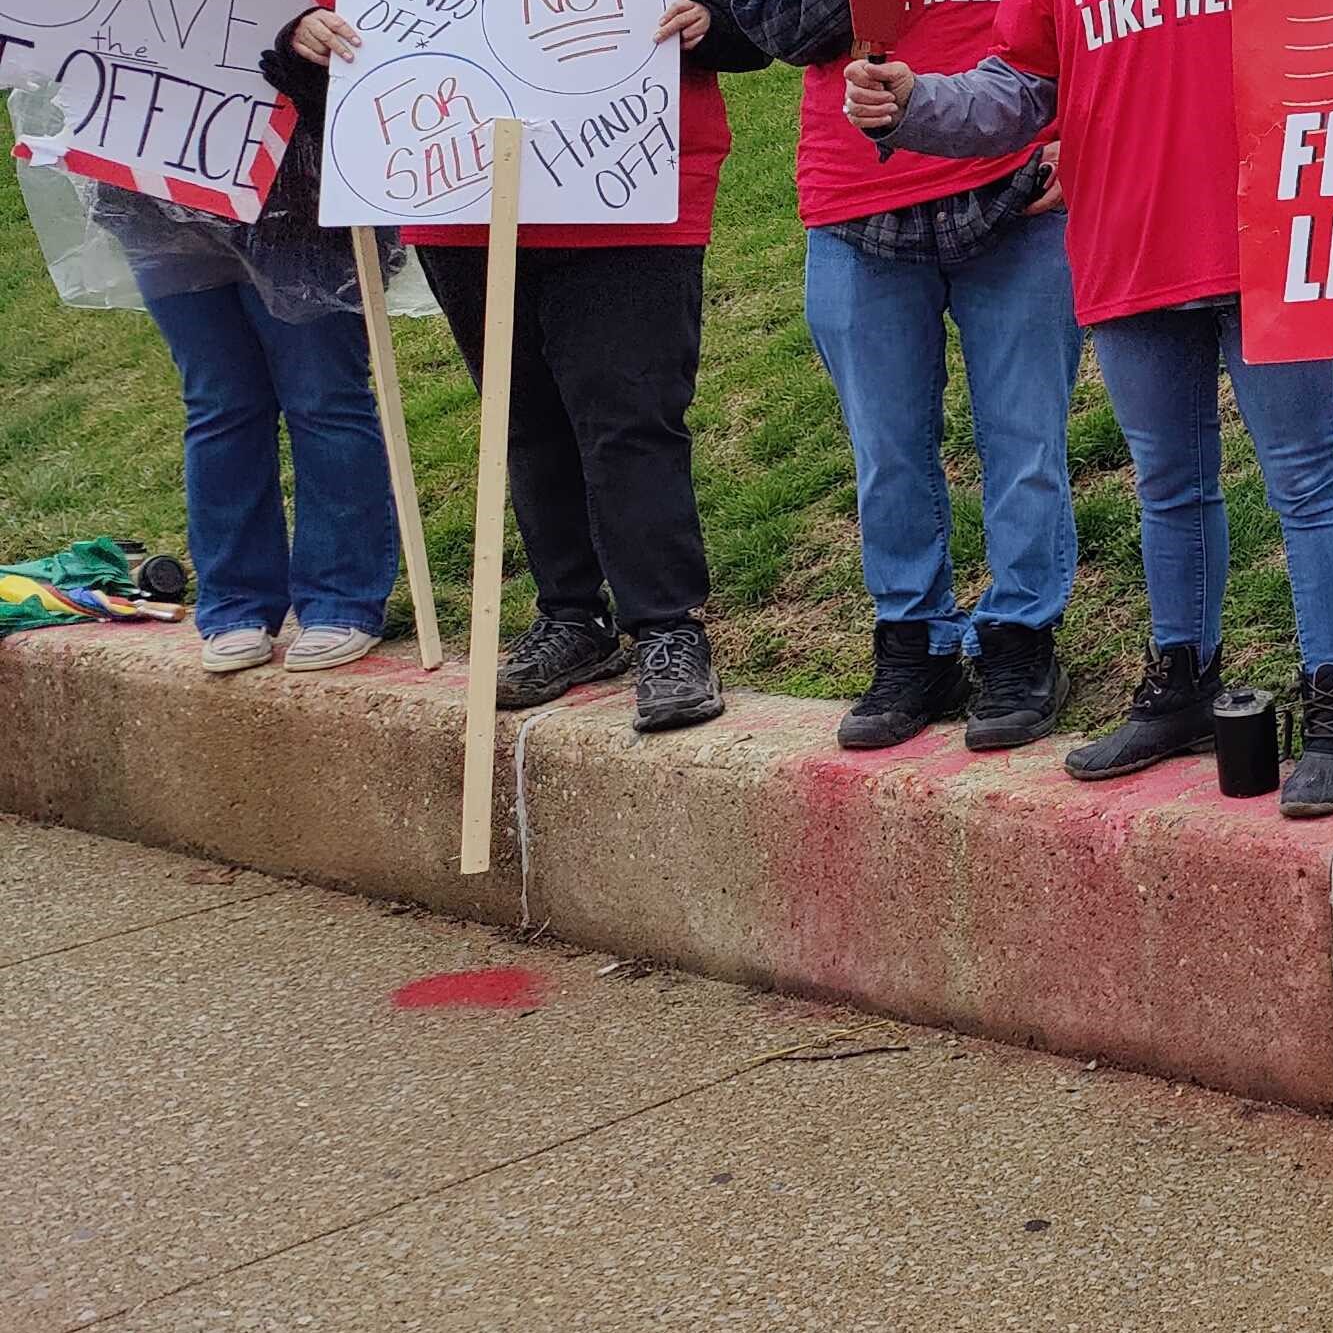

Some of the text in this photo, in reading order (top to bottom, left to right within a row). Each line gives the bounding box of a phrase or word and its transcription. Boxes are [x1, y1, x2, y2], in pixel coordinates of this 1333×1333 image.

[90, 26, 149, 59] the
[356, 0, 451, 50] OFF!
[373, 76, 479, 145] FOR
[531, 75, 670, 187] HANDS
[384, 121, 497, 202] SALE
[595, 119, 677, 209] OFF!
